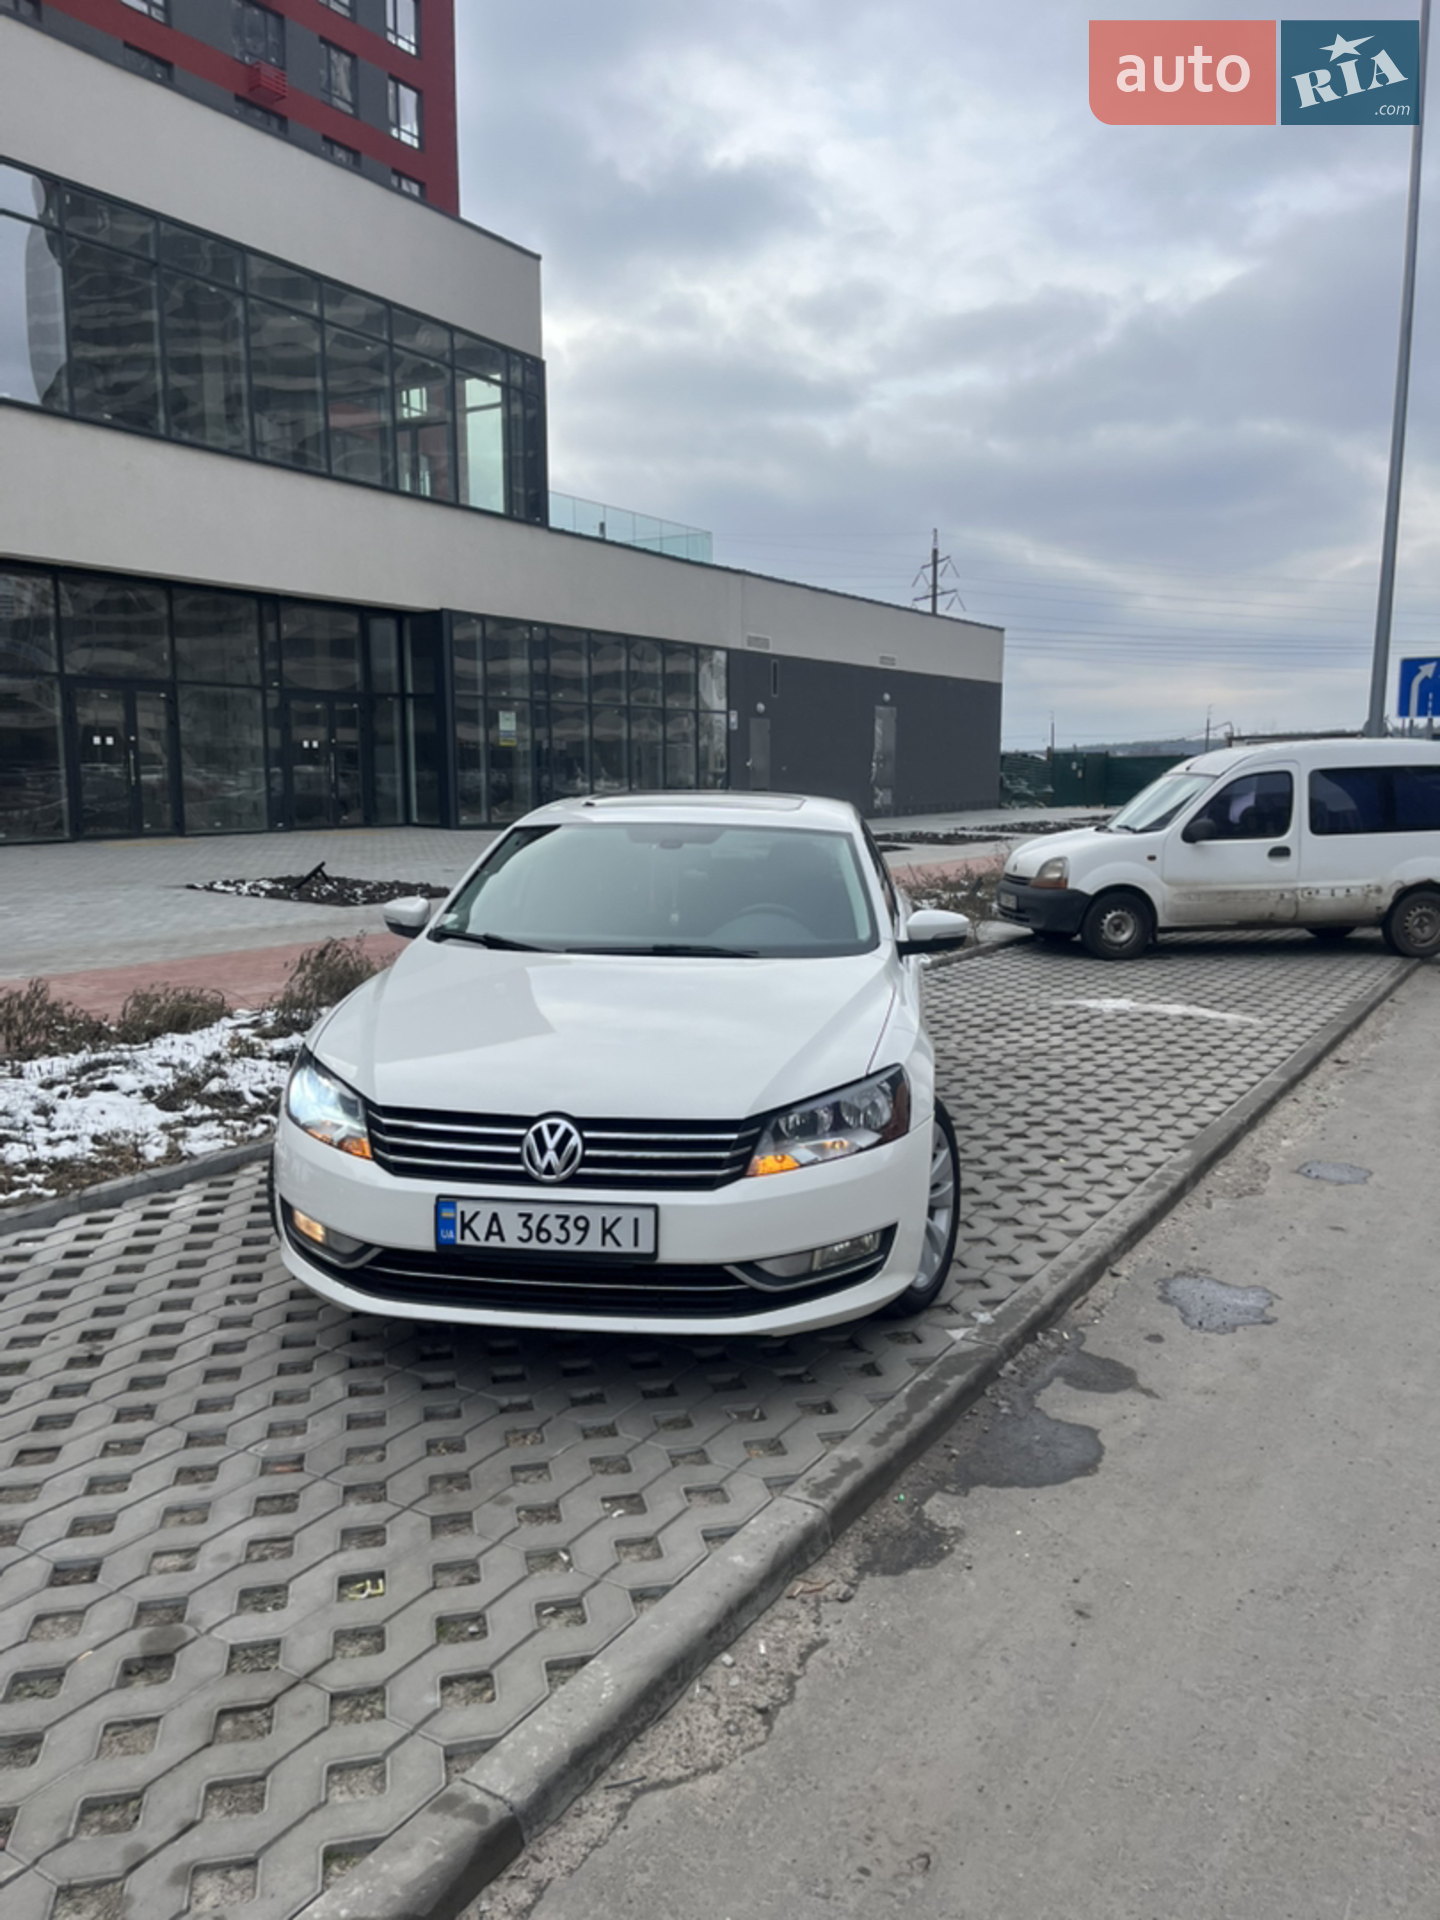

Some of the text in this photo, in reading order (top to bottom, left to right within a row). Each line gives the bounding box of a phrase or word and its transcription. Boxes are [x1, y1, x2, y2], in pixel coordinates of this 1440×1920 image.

[459, 1210, 640, 1248] KA 3639 KI
